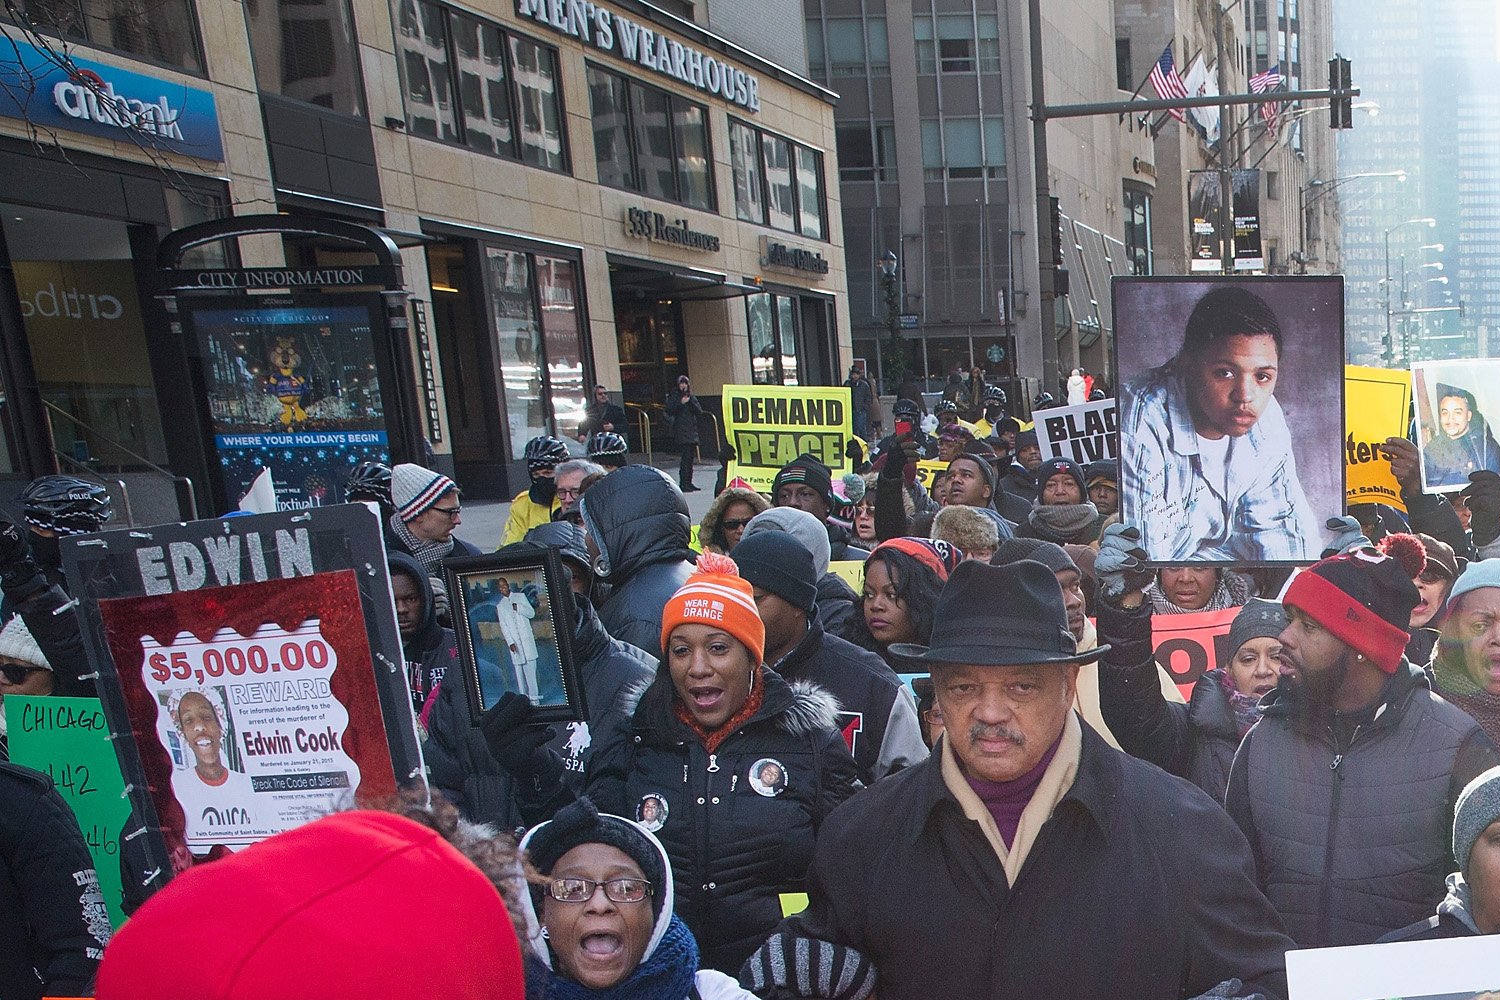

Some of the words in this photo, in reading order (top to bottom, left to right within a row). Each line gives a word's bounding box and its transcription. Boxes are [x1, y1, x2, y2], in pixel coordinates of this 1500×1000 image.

[614, 15, 760, 112] WEARHOUSE
[54, 82, 184, 141] citibank
[627, 206, 652, 242] 535
[654, 211, 720, 252] Residences
[197, 272, 238, 287] CITY
[246, 270, 364, 287] INFORMATION
[732, 397, 843, 427] DEMAND
[223, 436, 262, 446] WHERE
[264, 436, 293, 445] YOUR
[296, 434, 346, 445] HOLIDAYS
[348, 433, 379, 443] BEGIN
[738, 433, 842, 468] PEACE
[1359, 485, 1396, 497] Sabina
[136, 527, 314, 597] EDWIN
[683, 608, 723, 621] ORANGE
[684, 599, 709, 608] WEAR
[148, 639, 330, 685] $5,000.00
[230, 677, 332, 705] REWARD
[22, 703, 105, 733] CHICAGO
[250, 706, 285, 715] information
[286, 705, 309, 713] leading
[286, 714, 317, 723] murderer
[242, 729, 293, 757] Edwin
[295, 726, 341, 753] Cook
[562, 757, 584, 773] SPA
[253, 778, 271, 790] Break
[273, 777, 286, 788] The
[287, 776, 304, 789] Code
[310, 776, 318, 787] of
